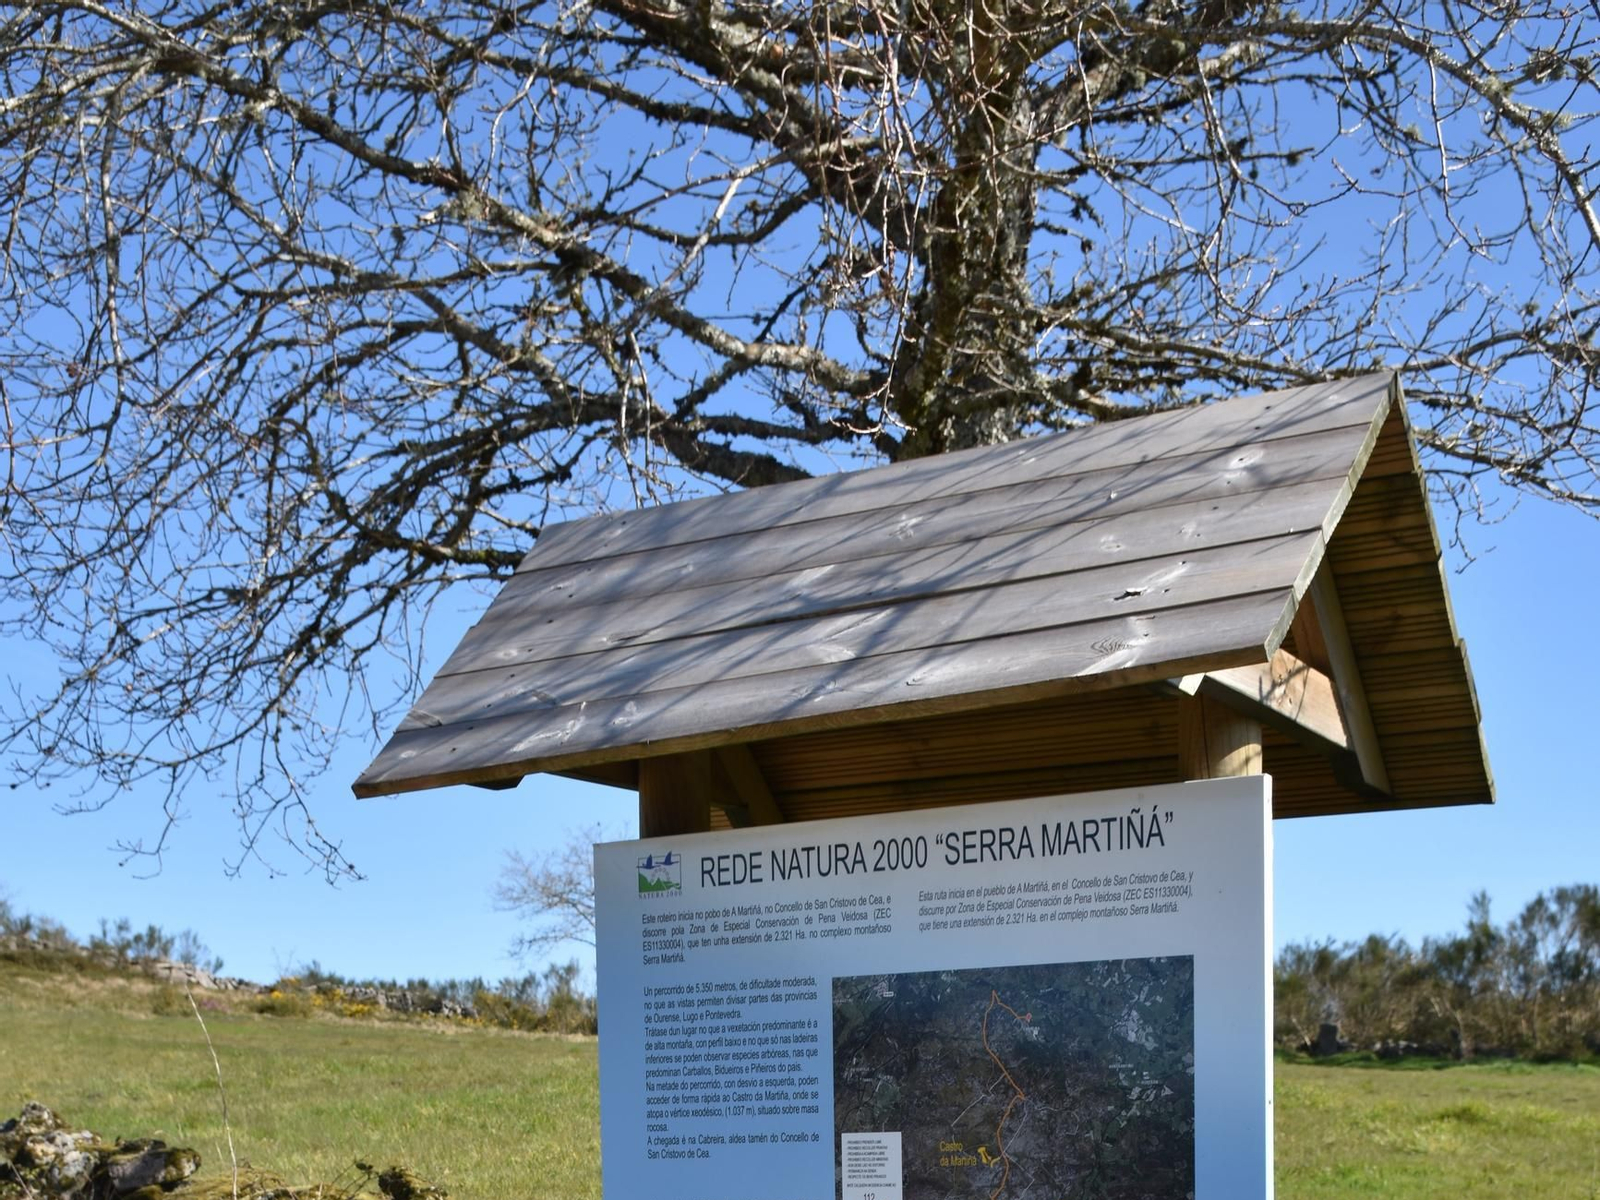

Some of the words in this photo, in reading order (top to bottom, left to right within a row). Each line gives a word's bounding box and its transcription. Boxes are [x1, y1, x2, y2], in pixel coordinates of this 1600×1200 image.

[701, 851, 763, 888] REDE
[771, 842, 867, 881] NATURA
[873, 836, 928, 872] 2000
[936, 826, 1034, 865] “SERRA
[1042, 805, 1174, 857] MARTIÑÁ”
[642, 913, 656, 924] Este
[657, 911, 676, 923] roteiro
[678, 910, 695, 921] inicia
[695, 912, 703, 920] no
[704, 908, 720, 921] pobo
[721, 907, 730, 918] de
[731, 906, 736, 917] A
[738, 904, 763, 918] Martiñá,
[764, 906, 773, 914] no
[775, 901, 802, 913] Concello
[804, 900, 813, 911] de
[815, 899, 828, 910] San
[829, 897, 857, 909] Cristovo
[858, 896, 867, 906] de
[868, 894, 885, 907] Cea,
[642, 926, 666, 938] discorre
[671, 924, 684, 938] pola
[689, 923, 705, 934] Zona
[710, 922, 718, 932] de
[724, 919, 750, 933] Especial
[756, 915, 799, 928] Conservación
[804, 914, 813, 925] de
[818, 912, 835, 924] Pena
[841, 910, 868, 922] Veidosa
[874, 908, 892, 921] (ZEC
[919, 922, 930, 934] que
[932, 919, 948, 930] tiene
[950, 920, 962, 929] una
[963, 915, 995, 928] extensión
[996, 915, 1004, 926] de
[1006, 913, 1024, 925] 2.321
[1026, 912, 1038, 923] Ha.
[1040, 914, 1048, 922] en
[1050, 911, 1056, 922] el
[1058, 909, 1088, 924] complejo
[1090, 906, 1128, 919] montañoso
[1130, 904, 1149, 916] Serra
[1150, 902, 1178, 914] Martiñá.
[642, 938, 684, 953] ES11330004),
[687, 940, 699, 950] que
[701, 936, 712, 947] ten
[713, 935, 730, 946] unha
[732, 933, 762, 945] extensión
[764, 932, 773, 942] de
[775, 930, 793, 942] 2.321
[796, 930, 807, 940] Ha.
[809, 931, 818, 939] no
[820, 926, 852, 941] complexo
[854, 924, 892, 936] montañoso
[643, 954, 659, 965] Serra
[661, 952, 685, 964] Martiñá.
